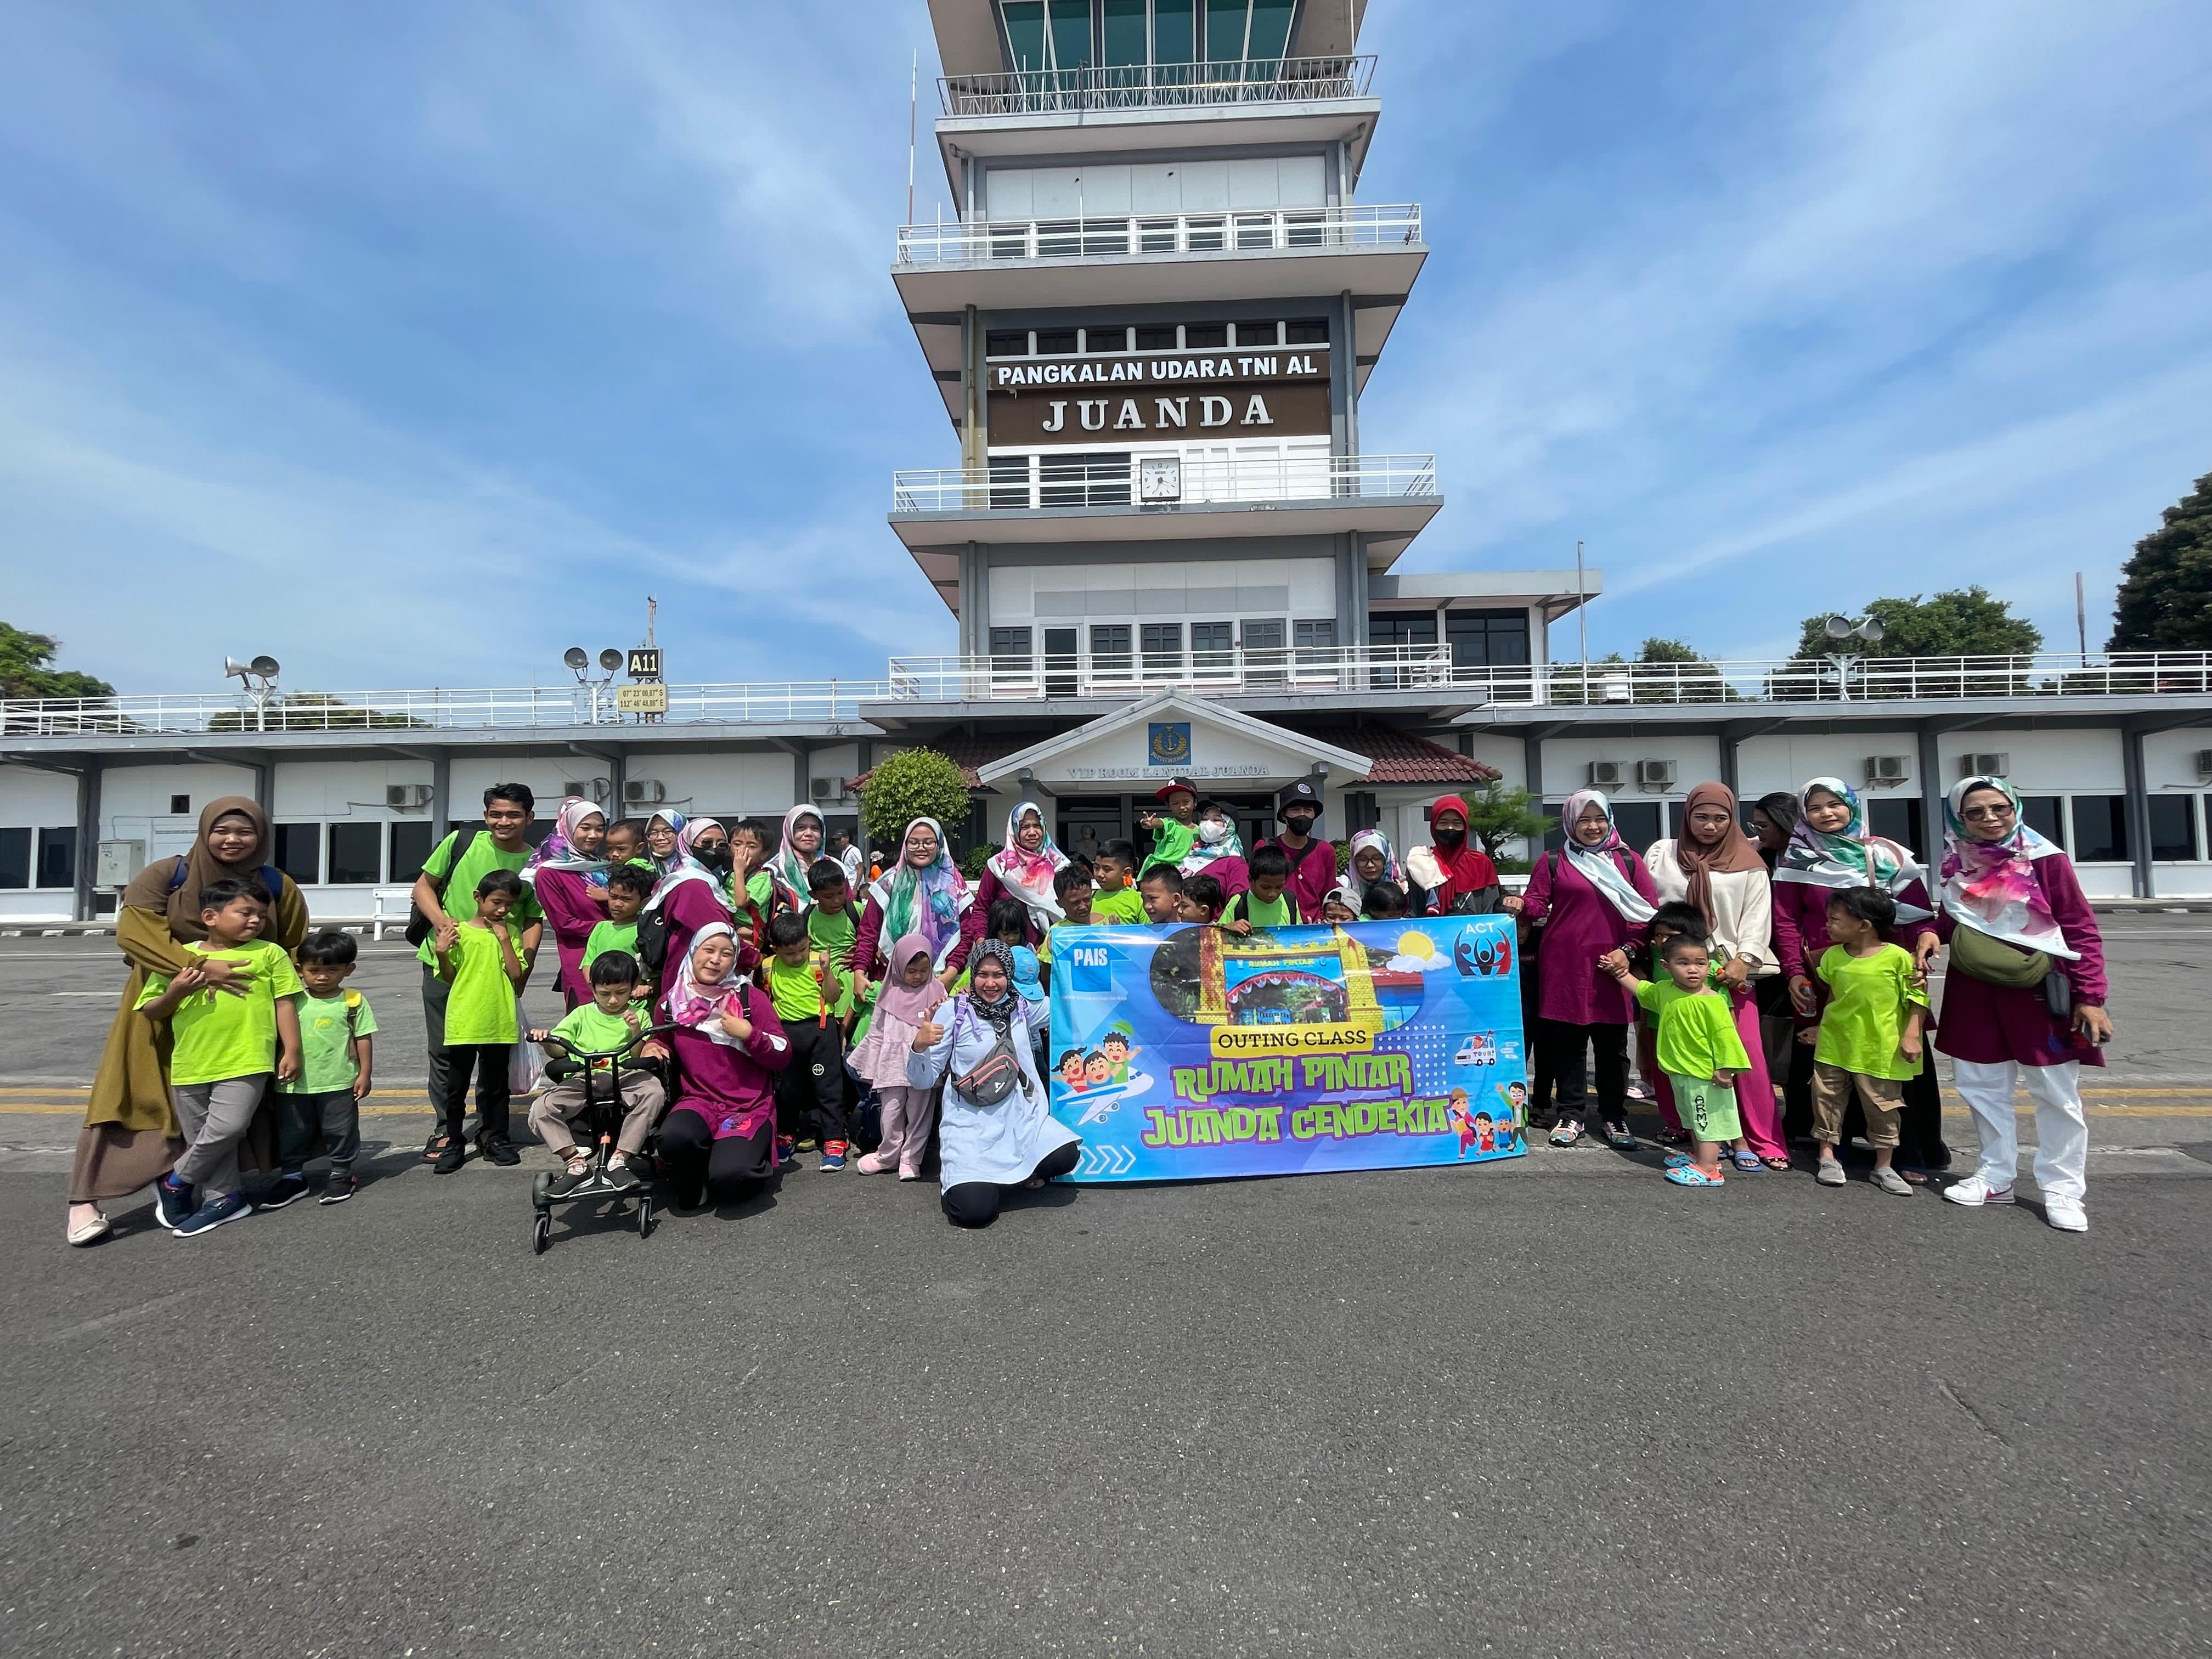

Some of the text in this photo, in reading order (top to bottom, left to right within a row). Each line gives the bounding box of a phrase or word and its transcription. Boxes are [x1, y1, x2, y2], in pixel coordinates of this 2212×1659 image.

[998, 356, 1317, 385] PANGKALAN UDARA TNI AL
[1042, 394, 1274, 432] JUANDA
[630, 654, 657, 672] A11
[1066, 765, 1269, 778] VIP ROOM LANUDAL JUANDA
[1465, 922, 1494, 934] ACT
[1074, 948, 1108, 967] PAIS
[1218, 1029, 1367, 1049] OUTING CLASS
[1172, 1052, 1413, 1103] RUMAH PINTAR
[1143, 1097, 1451, 1146] JUANDA CENDEKIA
[1695, 1094, 1708, 1132] ARMY
